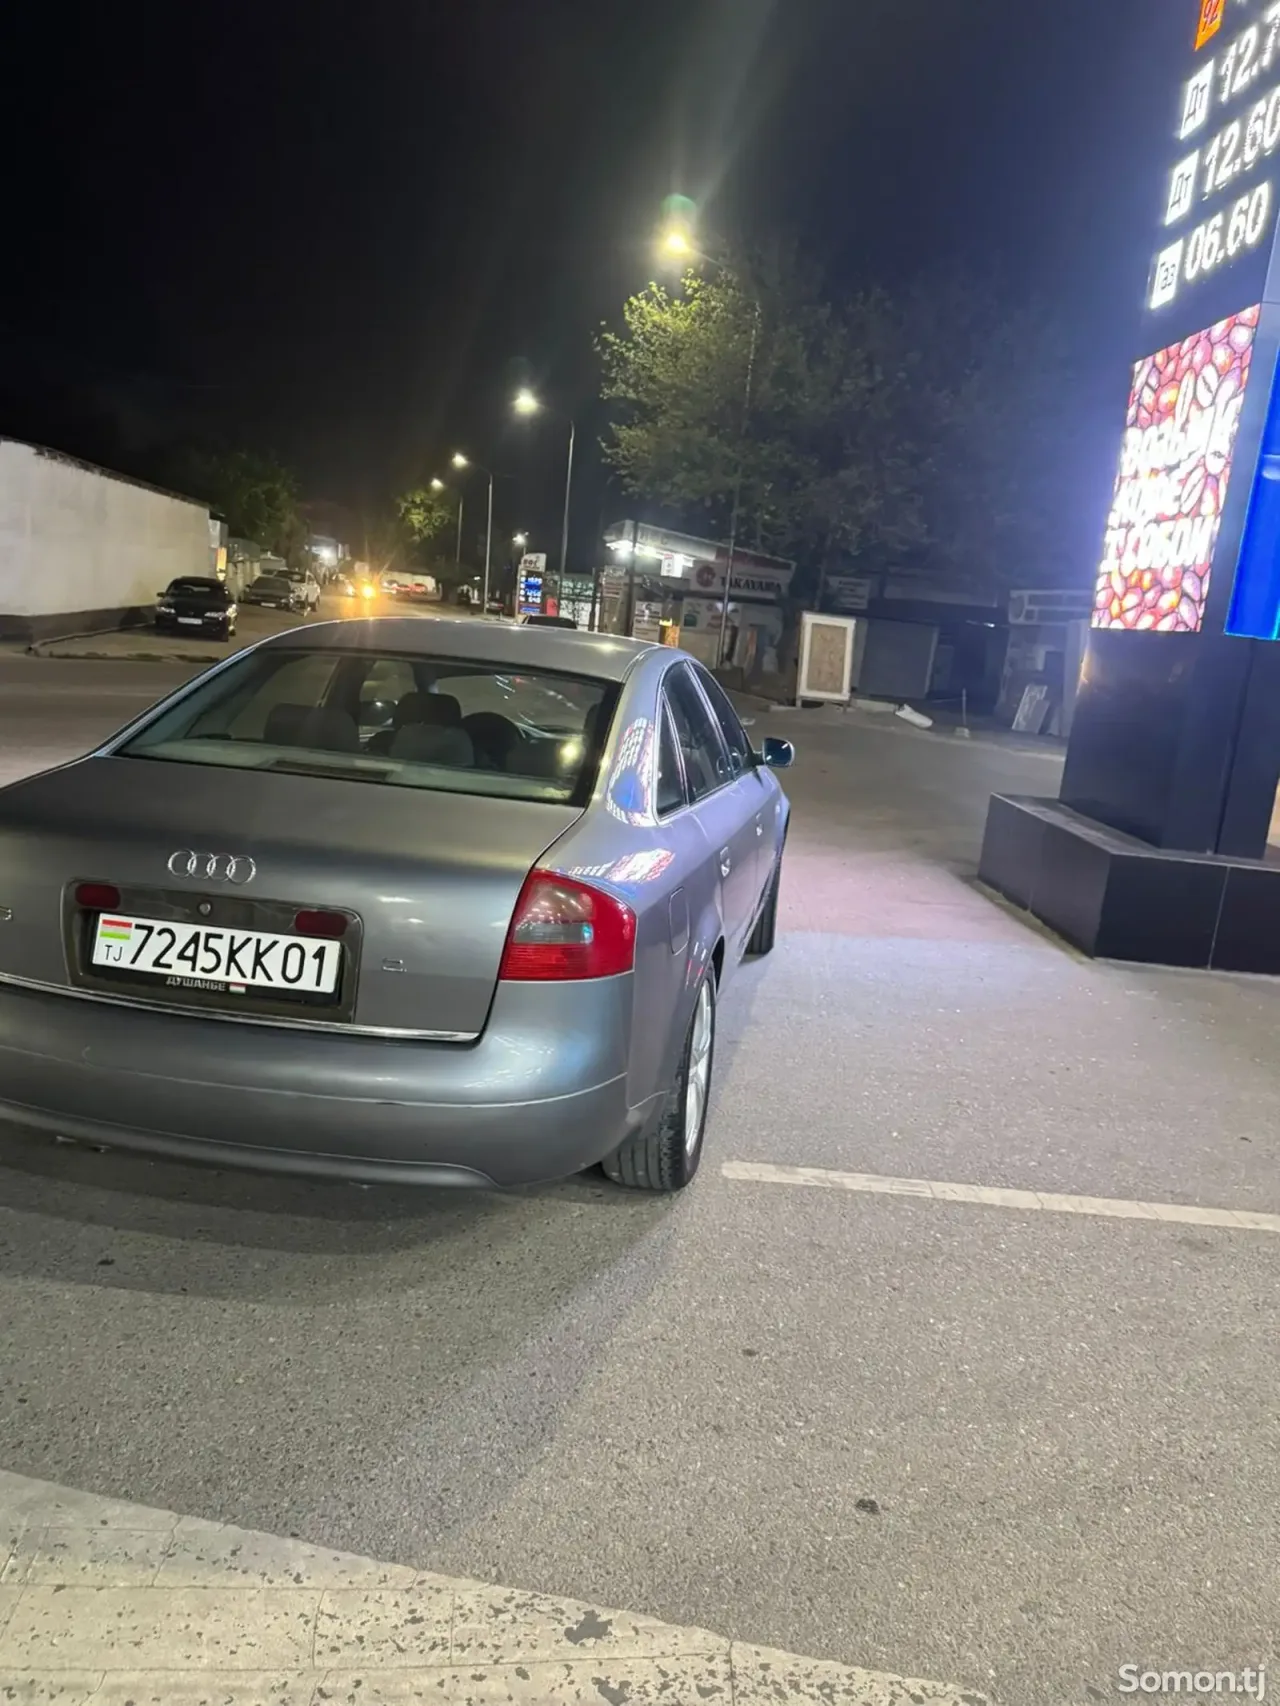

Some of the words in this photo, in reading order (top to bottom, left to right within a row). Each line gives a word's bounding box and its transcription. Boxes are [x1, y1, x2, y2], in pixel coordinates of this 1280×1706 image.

[1204, 85, 1280, 194] 12.60
[1185, 181, 1269, 280] 06.60
[104, 944, 123, 962] TJ
[130, 923, 327, 987] 7245KK01
[166, 976, 227, 992] ДУШАНБЕ
